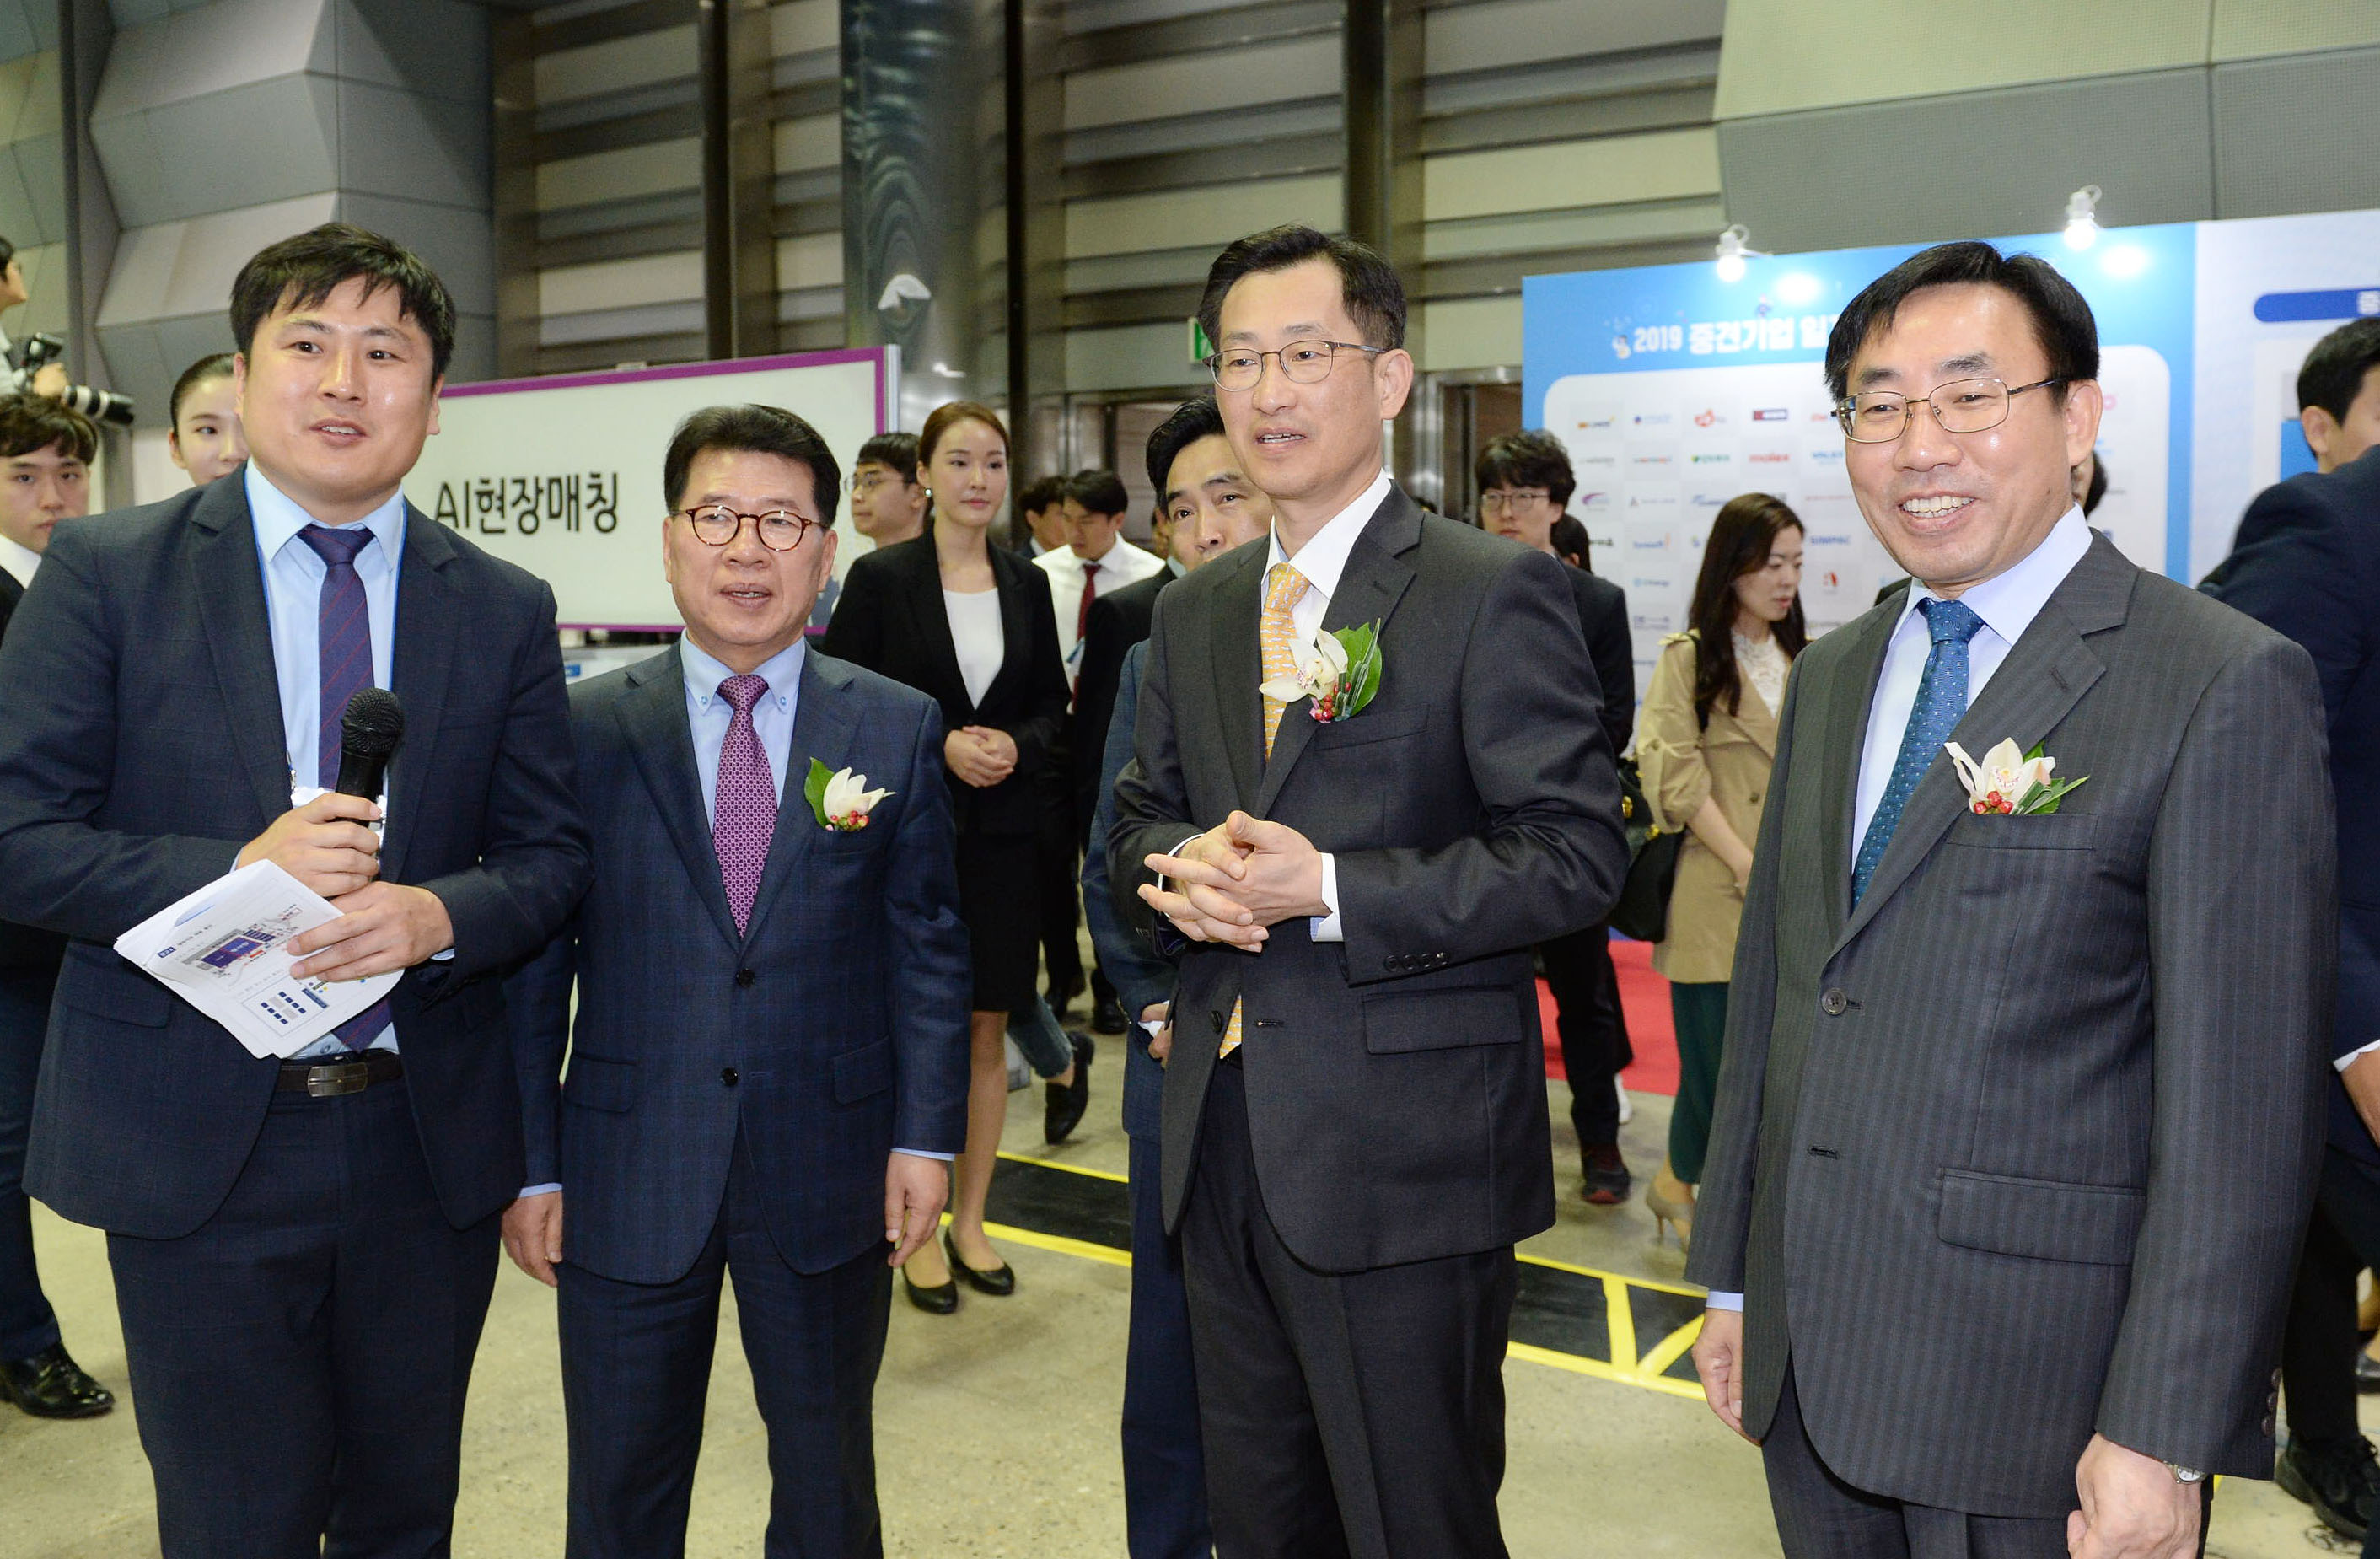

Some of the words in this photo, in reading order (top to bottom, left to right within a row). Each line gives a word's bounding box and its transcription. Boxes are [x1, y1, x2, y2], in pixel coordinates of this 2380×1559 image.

[1633, 324, 1683, 353] 2019
[1689, 316, 1795, 355] 중견기업
[1799, 314, 1840, 349] 일
[433, 471, 618, 535] AI현장매칭
